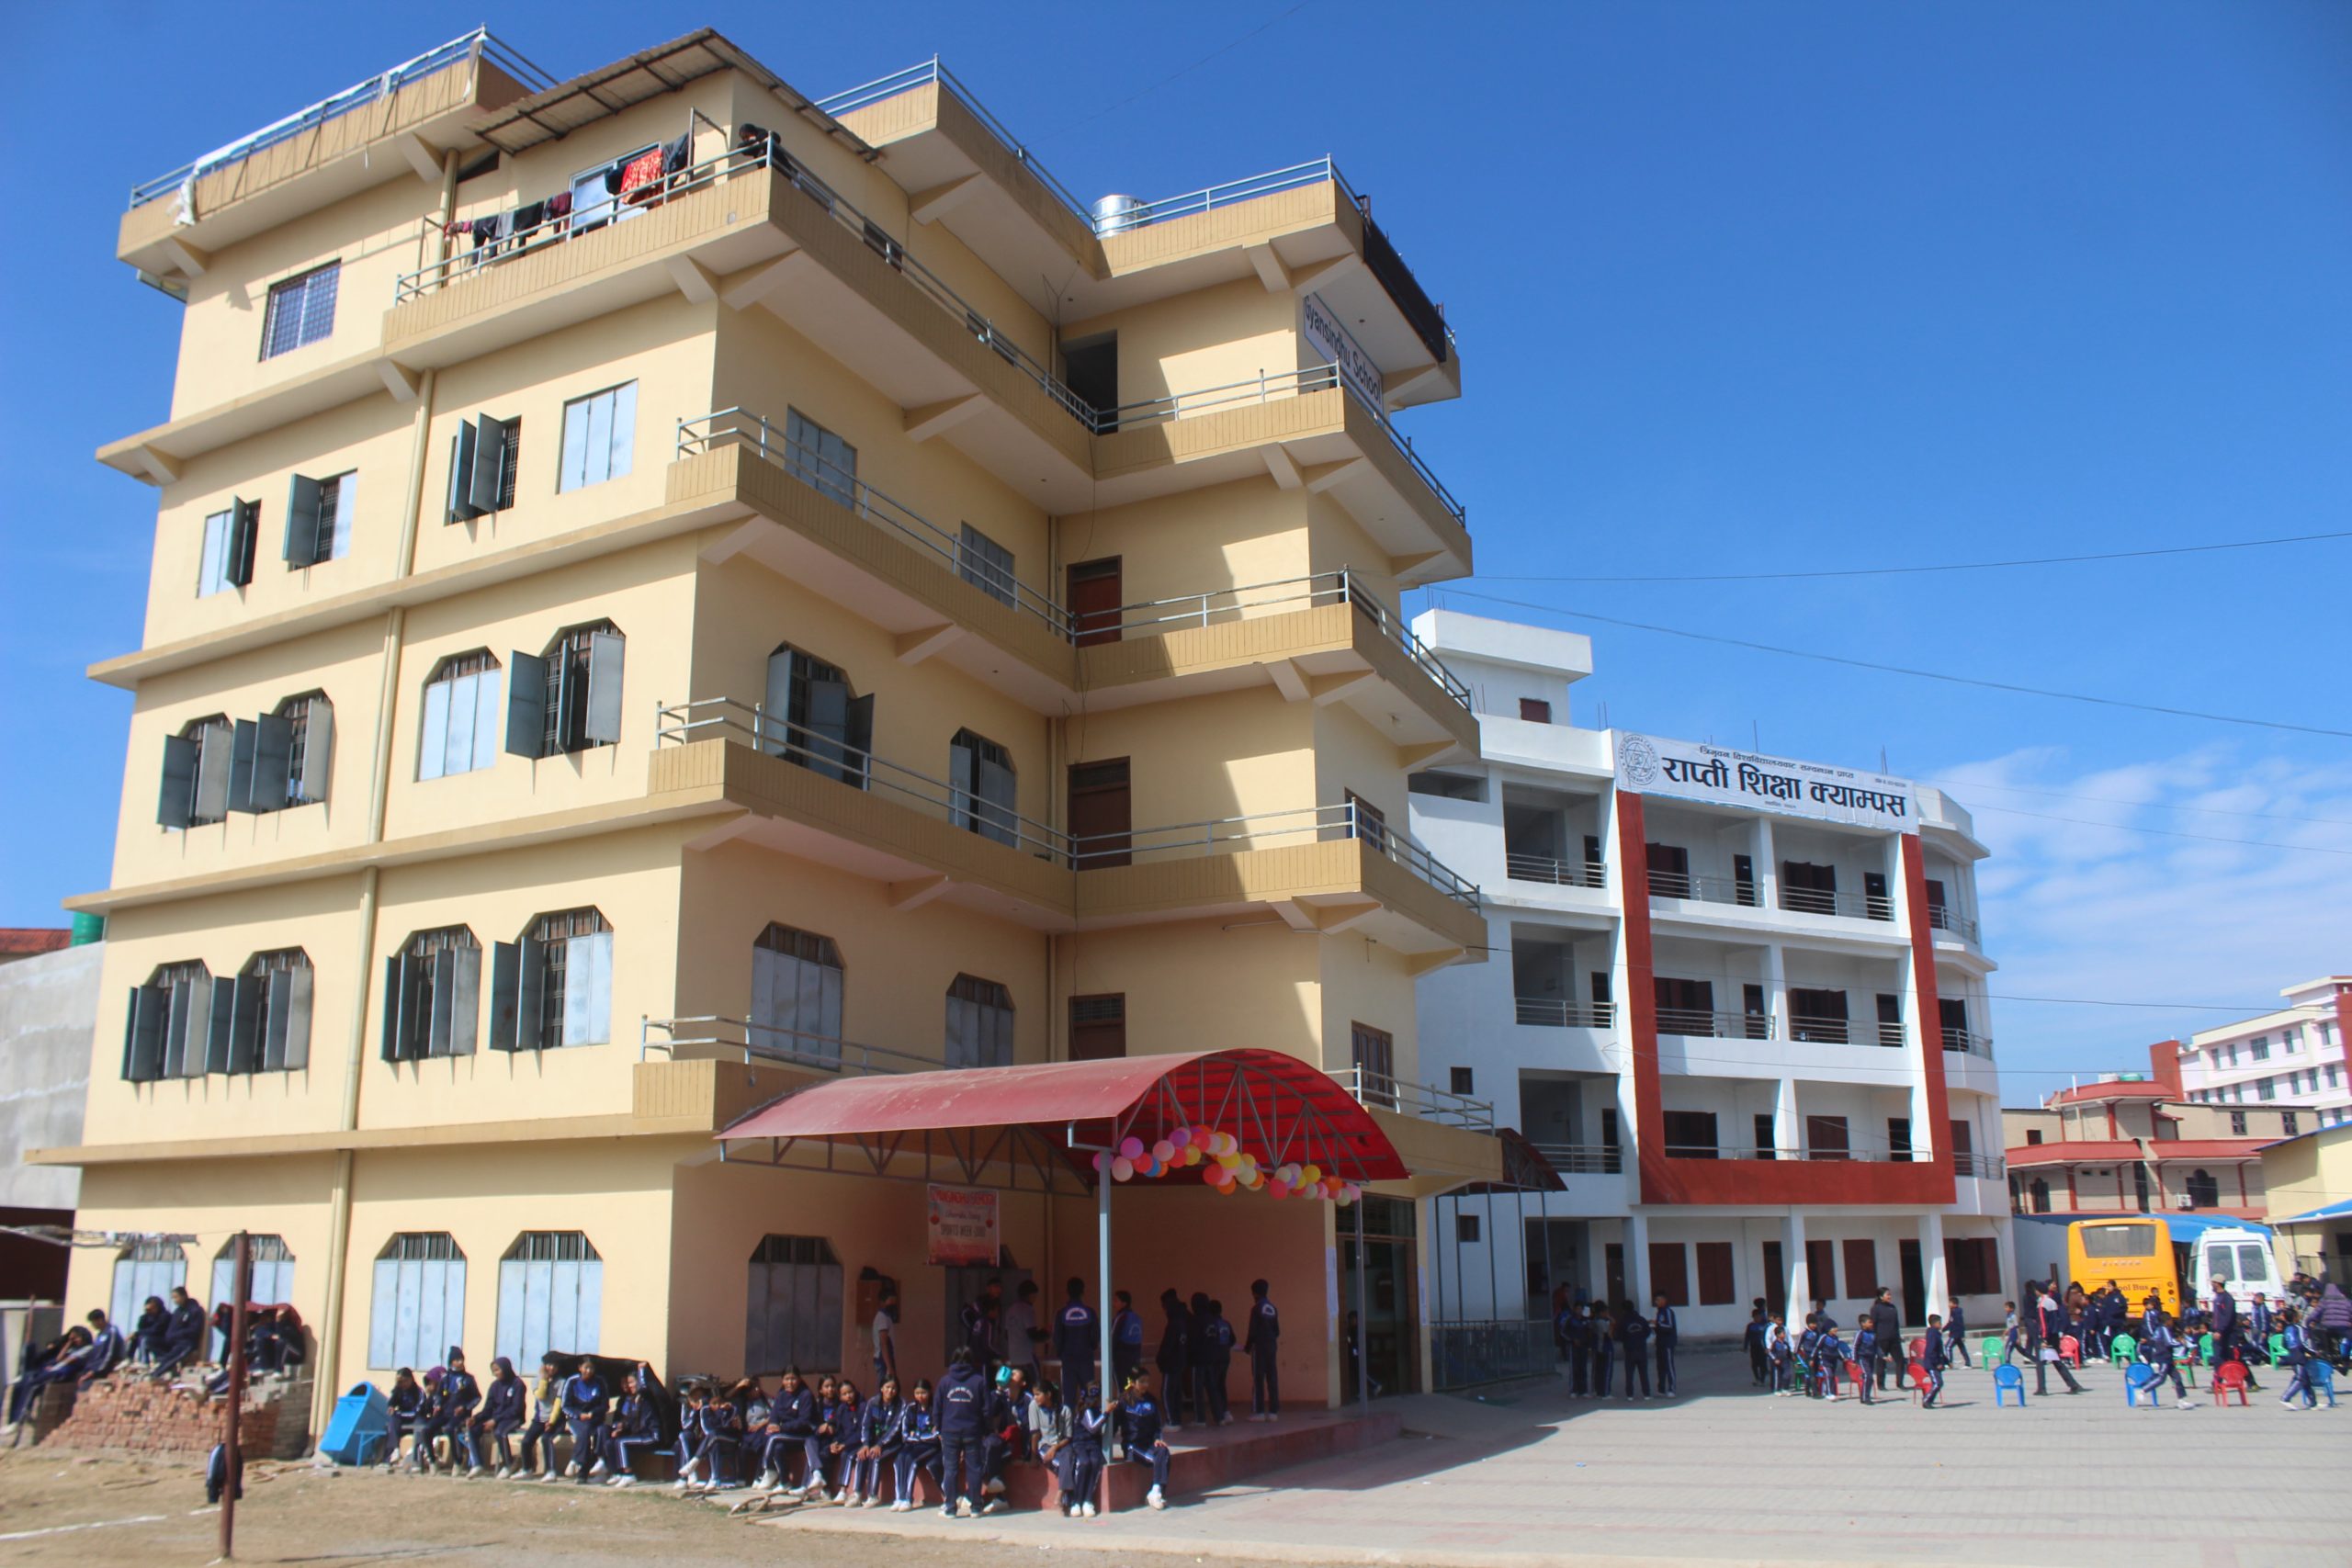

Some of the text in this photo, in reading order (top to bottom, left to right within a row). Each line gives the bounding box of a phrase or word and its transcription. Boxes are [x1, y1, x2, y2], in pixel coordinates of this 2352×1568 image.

[1305, 294, 1382, 405] Gyansindhu School
[1662, 758, 1906, 818] राप्ती शिक्षा क्याम्पस
